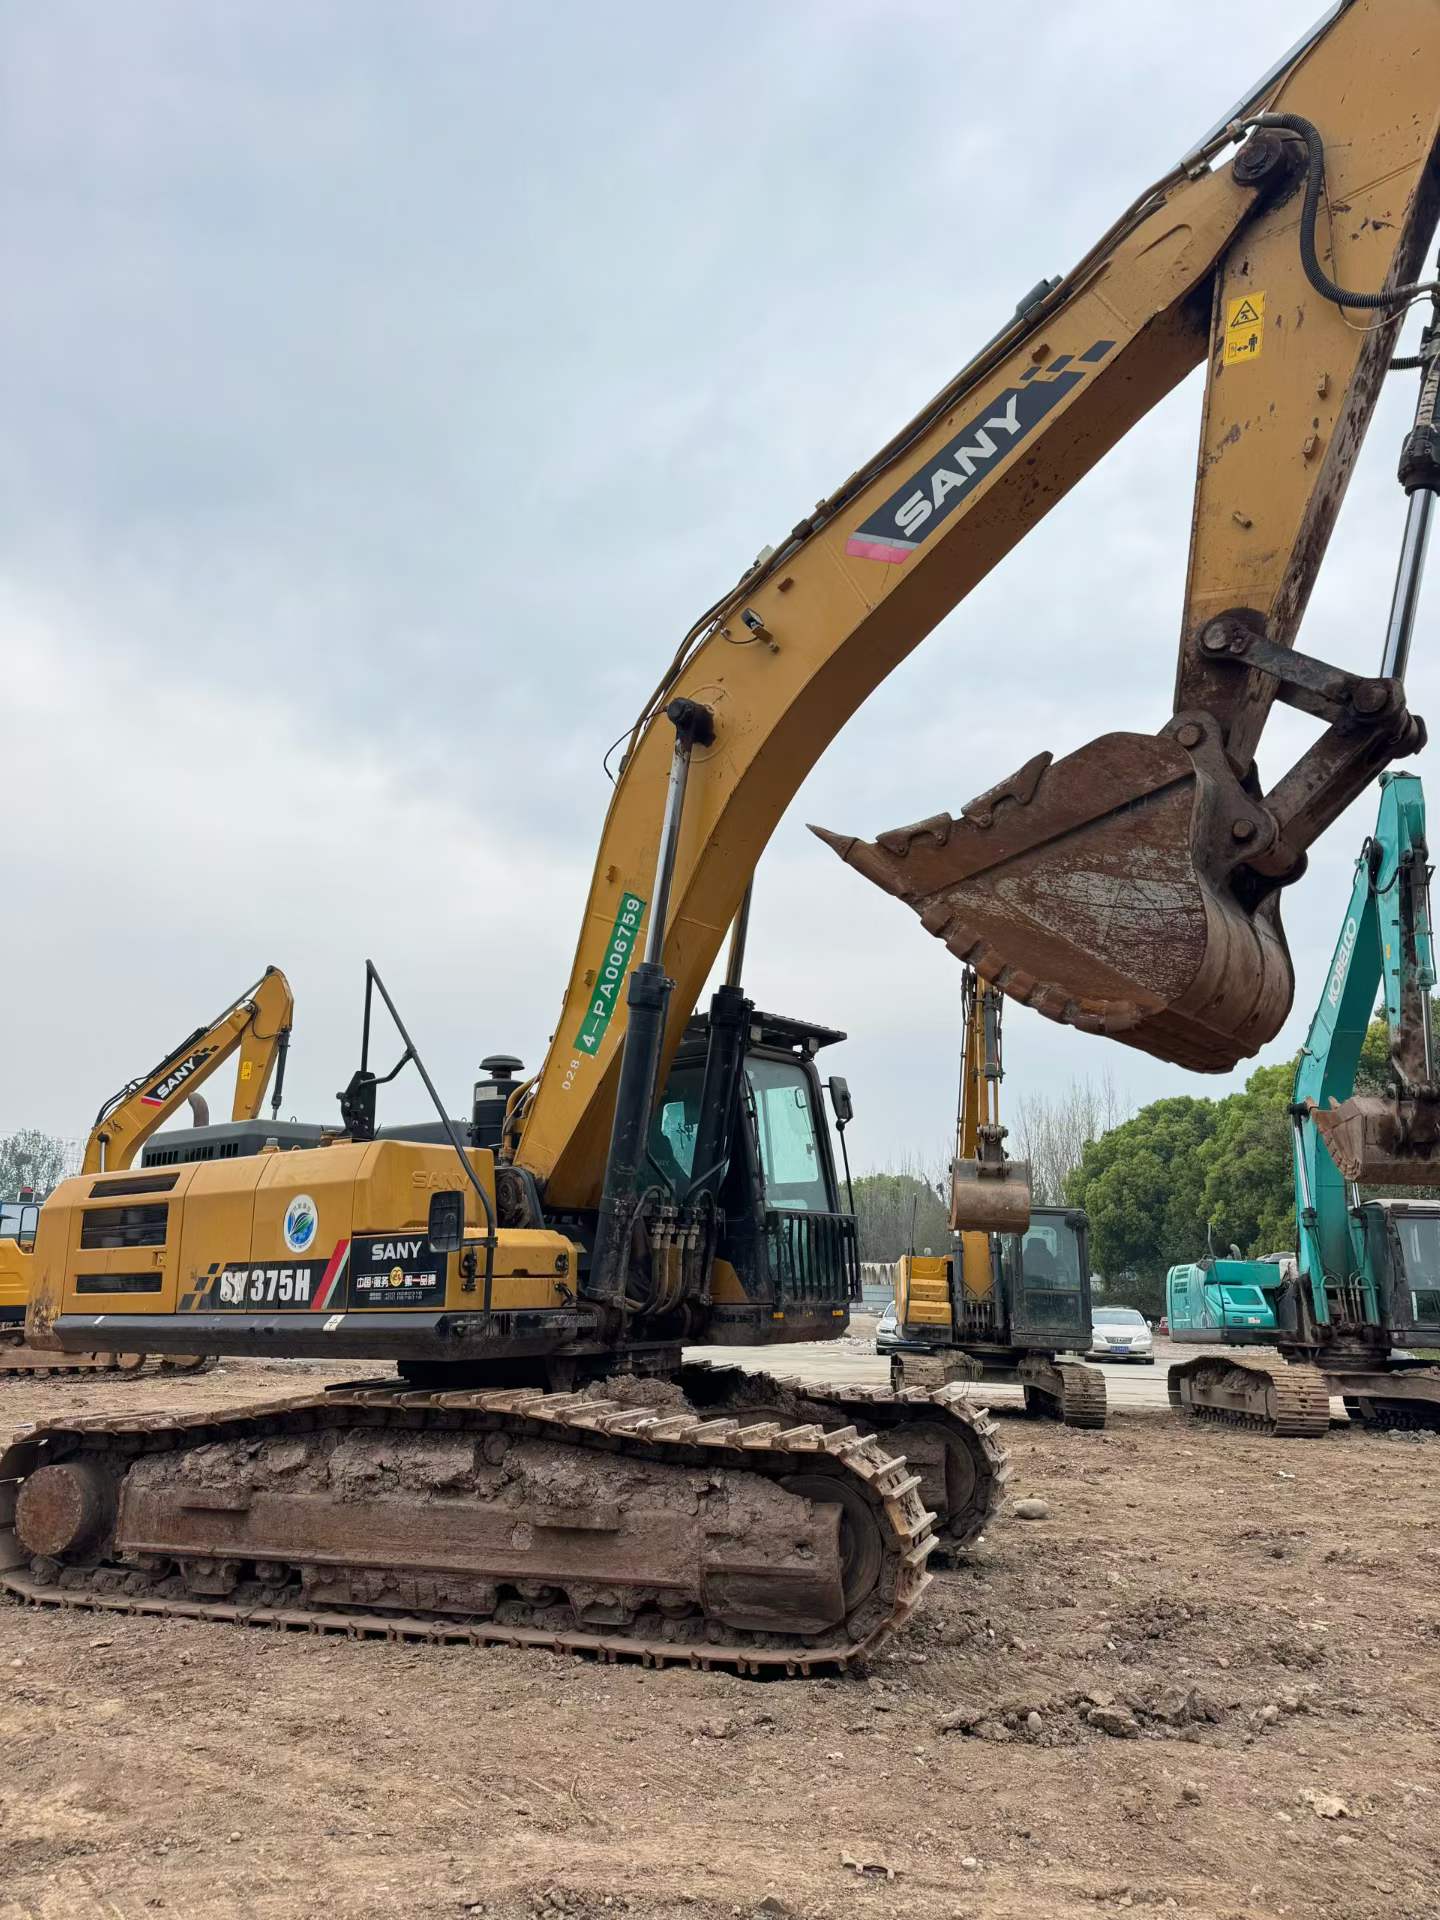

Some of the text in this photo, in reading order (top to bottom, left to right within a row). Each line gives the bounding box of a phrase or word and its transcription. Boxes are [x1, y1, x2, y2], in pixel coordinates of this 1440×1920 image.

[895, 394, 1021, 537] SANY
[1328, 917, 1356, 1008] KOBELCO
[157, 1057, 195, 1099] SANY
[412, 1170, 470, 1191] SANY
[371, 1241, 422, 1260] SANY
